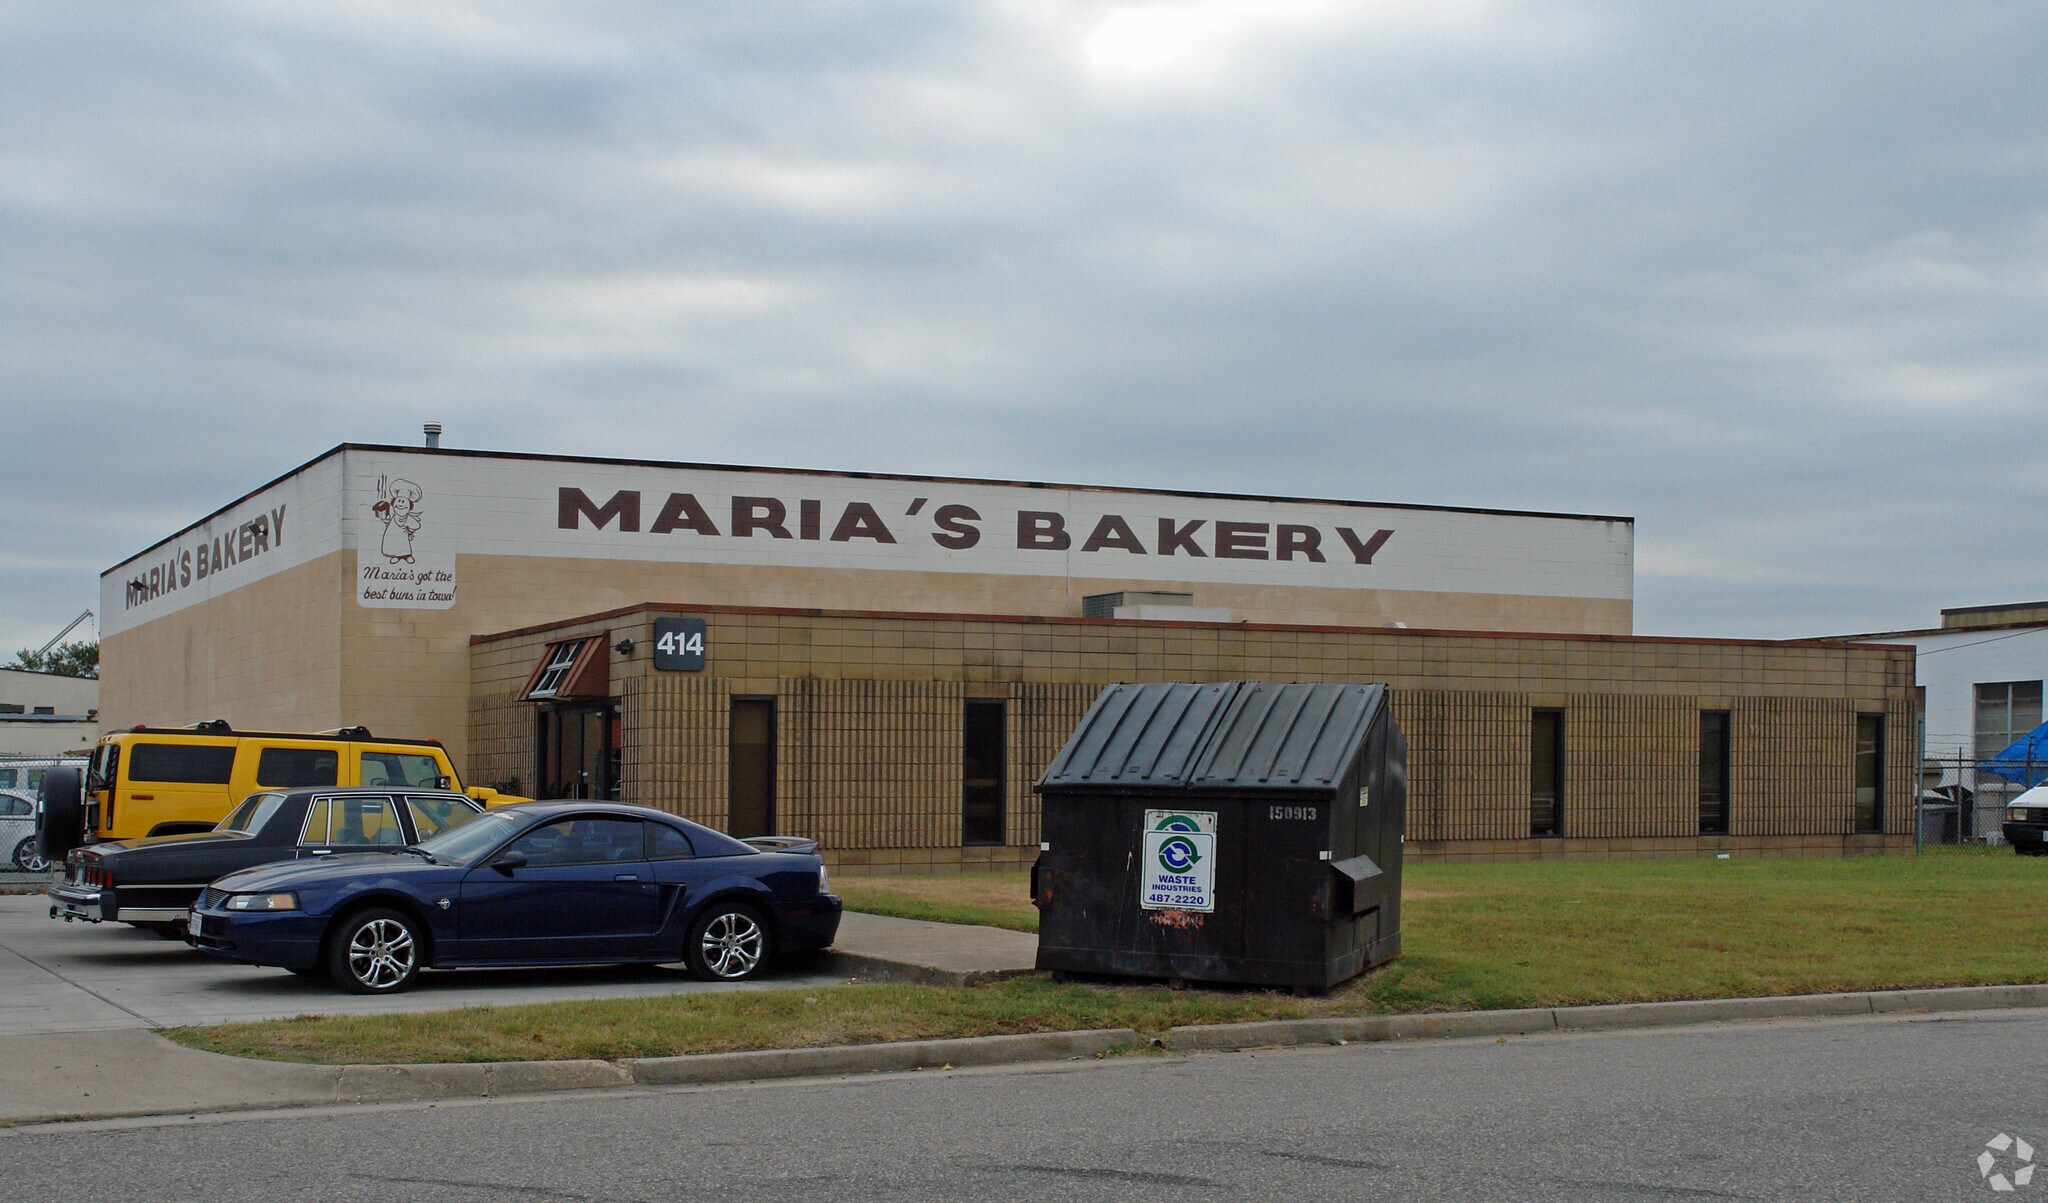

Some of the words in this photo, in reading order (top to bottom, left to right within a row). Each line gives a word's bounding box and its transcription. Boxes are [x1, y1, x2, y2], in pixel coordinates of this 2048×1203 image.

[558, 486, 982, 550] MARIA'S
[1016, 510, 1396, 565] BAKERY
[125, 547, 192, 611] MARIA'S
[196, 503, 287, 581] BAKERY
[363, 566, 415, 581] Maria's
[415, 569, 433, 586] got
[435, 569, 453, 582] the
[363, 585, 389, 600] best
[389, 586, 414, 601] buns
[416, 588, 426, 601] in
[657, 631, 704, 656] 414
[1269, 805, 1317, 821] 150913
[1158, 874, 1197, 885] WASTE
[1151, 883, 1203, 894] INDUSTRIES
[1149, 893, 1205, 905] 487-2220
